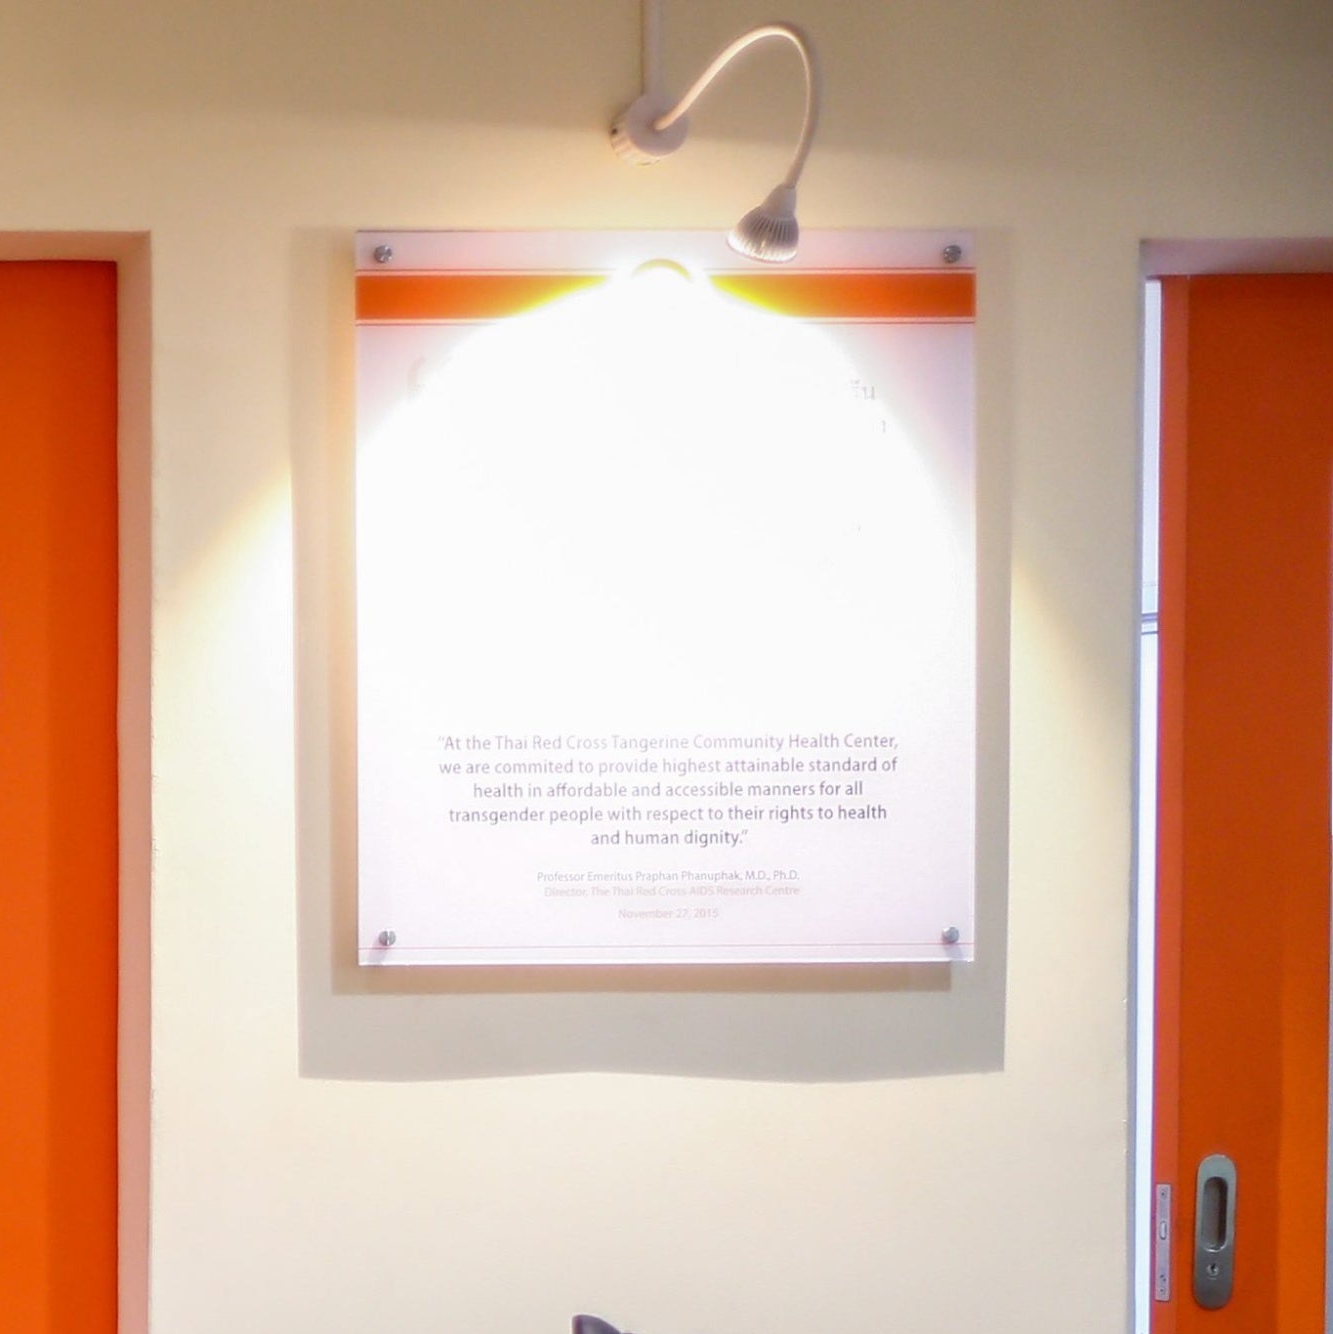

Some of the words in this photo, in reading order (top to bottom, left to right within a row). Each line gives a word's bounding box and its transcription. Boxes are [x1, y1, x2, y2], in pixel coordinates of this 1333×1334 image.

[465, 734, 492, 751] the
[494, 734, 529, 751] Thai
[532, 734, 563, 750] Red
[565, 734, 608, 750] Cross
[610, 734, 690, 753] Tangerine
[692, 733, 785, 753] Community
[788, 732, 841, 749] Health
[843, 732, 900, 750] Center,
[438, 762, 462, 775] we
[465, 762, 491, 775] are
[494, 758, 575, 774] commited
[578, 760, 595, 774] to
[598, 758, 659, 777] provide
[662, 757, 721, 777] highest
[724, 756, 805, 773] attainable
[807, 756, 878, 773] standard
[880, 756, 899, 772] of
[472, 782, 524, 798] health
[527, 783, 543, 798] in
[546, 781, 628, 798] affordable
[631, 781, 662, 797] and
[665, 781, 744, 797] accessible
[747, 784, 816, 797] manners
[818, 780, 841, 796] for
[844, 780, 864, 796] all
[448, 806, 545, 826] transgender
[549, 805, 604, 825] people
[607, 805, 642, 821] with
[645, 807, 704, 825] respect
[707, 807, 724, 821] to
[727, 804, 765, 821] their
[768, 804, 814, 824] rights
[816, 806, 834, 820] to
[837, 804, 888, 820] health
[590, 829, 621, 846] and
[624, 829, 680, 845] human
